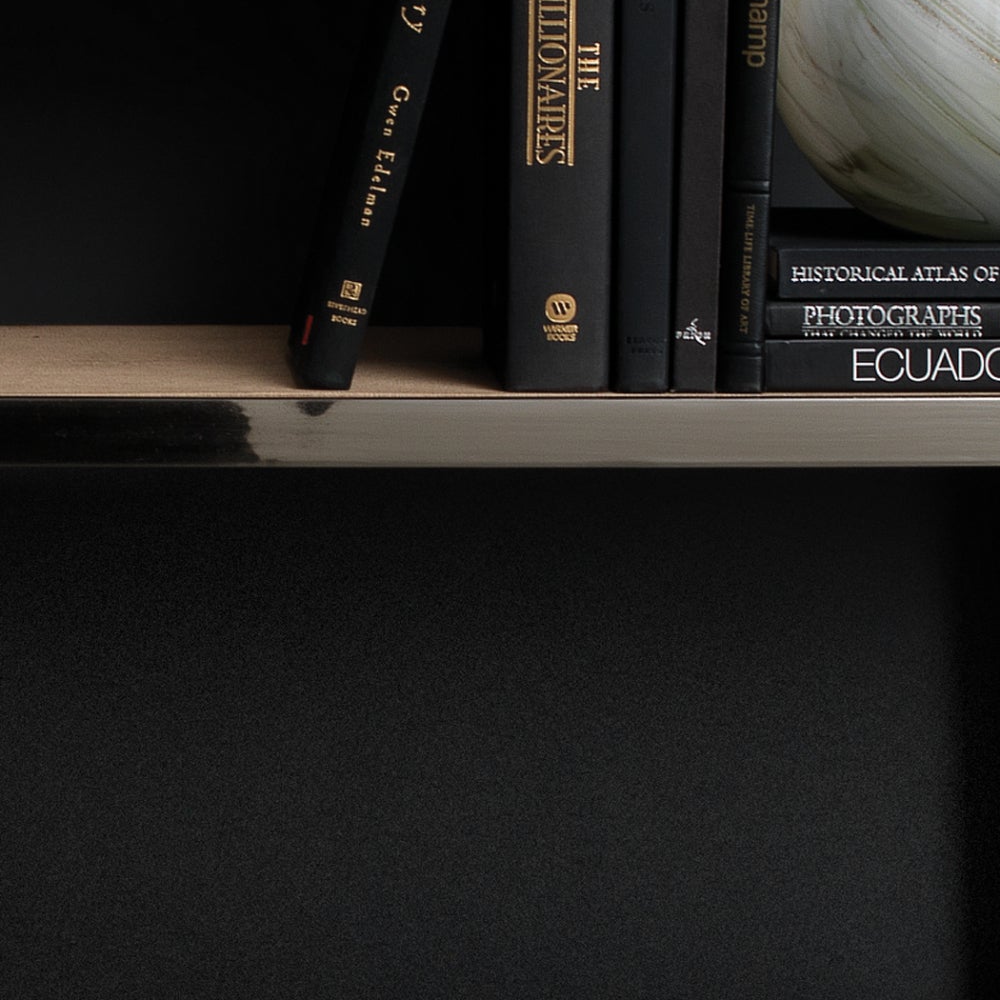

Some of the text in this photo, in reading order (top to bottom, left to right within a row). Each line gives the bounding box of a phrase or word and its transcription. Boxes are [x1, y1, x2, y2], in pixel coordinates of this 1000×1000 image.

[576, 42, 601, 92] THE
[360, 148, 396, 228] Edelman
[791, 266, 909, 282] HISTORICAL
[910, 266, 969, 282] ATLAS
[973, 266, 1000, 282] OF
[802, 305, 983, 326] PHOTOGRAPHS
